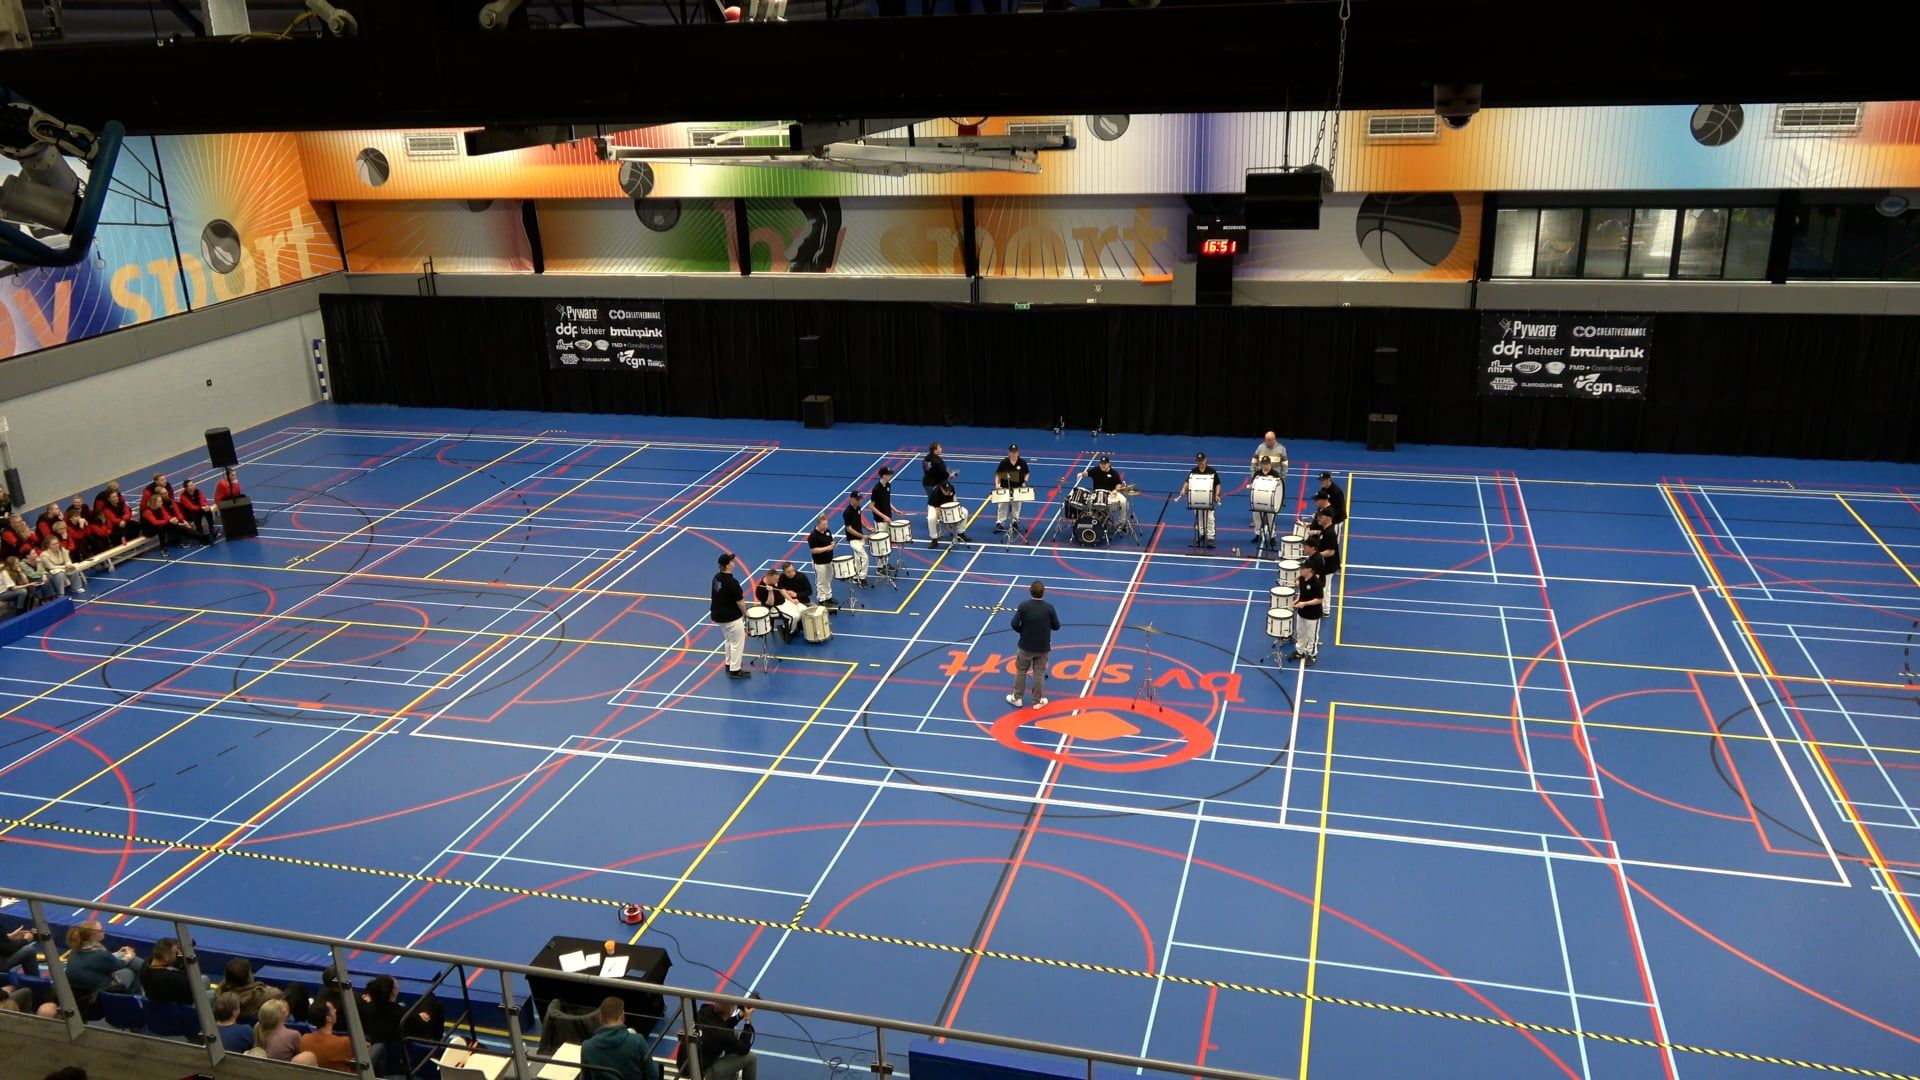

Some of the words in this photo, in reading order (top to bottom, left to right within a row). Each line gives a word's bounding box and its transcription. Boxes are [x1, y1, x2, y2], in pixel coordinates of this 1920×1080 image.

[711, 198, 847, 273] b
[1204, 239, 1237, 253] 16:51
[566, 305, 598, 321] Pyware
[608, 309, 626, 320] CO
[555, 322, 578, 338] ddf
[580, 326, 606, 335] beheer
[610, 326, 663, 339] brainpink
[1513, 320, 1557, 339] Pyware
[1572, 325, 1597, 338] CO
[1492, 340, 1524, 359] ddf
[1527, 345, 1565, 356] beheer
[1570, 346, 1645, 360] brainpink
[625, 356, 646, 369] cgn
[1585, 382, 1613, 396] cgn
[1151, 667, 1246, 704] bv
